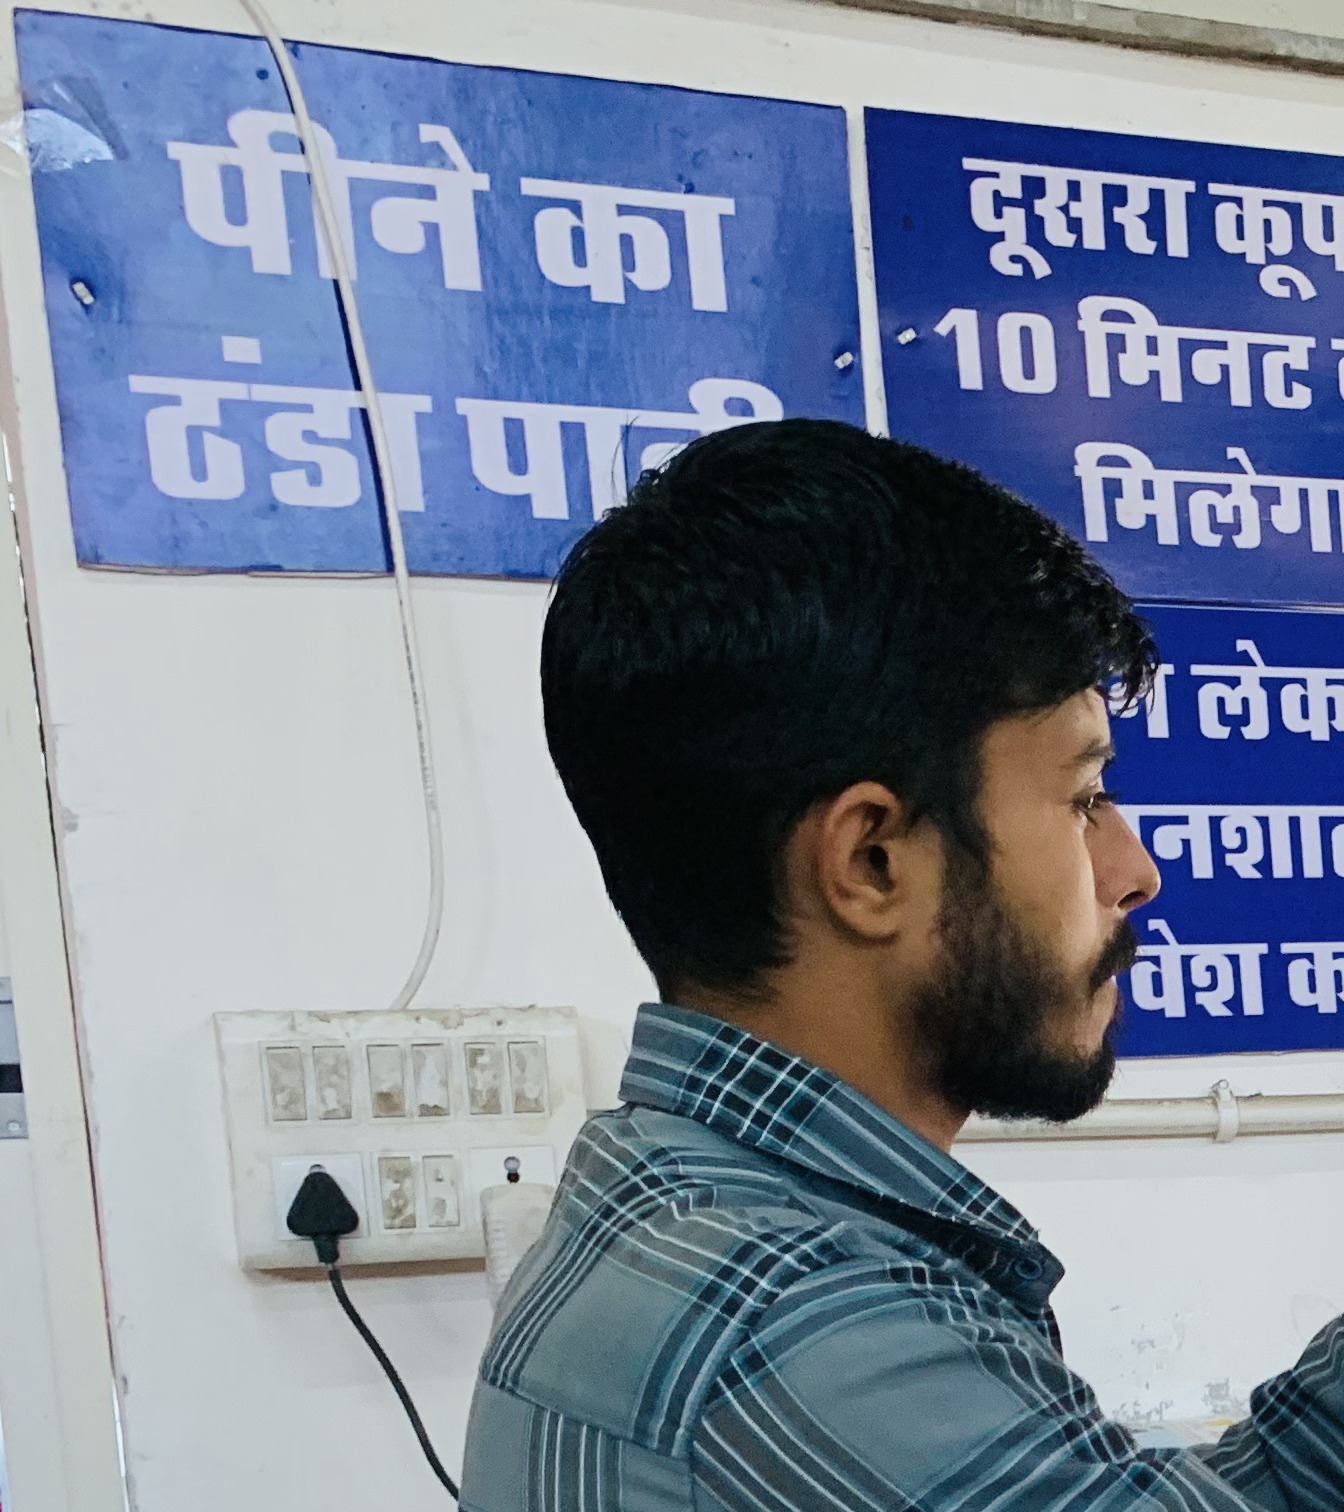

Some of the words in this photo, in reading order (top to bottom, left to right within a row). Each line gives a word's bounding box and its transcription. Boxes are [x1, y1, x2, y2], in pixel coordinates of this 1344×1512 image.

[168, 109, 490, 291] पीने
[521, 178, 735, 313] का
[962, 157, 1195, 280] दूसरा
[934, 308, 1056, 394] 10
[1077, 296, 1315, 410] मिनट
[127, 336, 432, 512] ठंडा
[1129, 919, 1269, 1018] वेश
